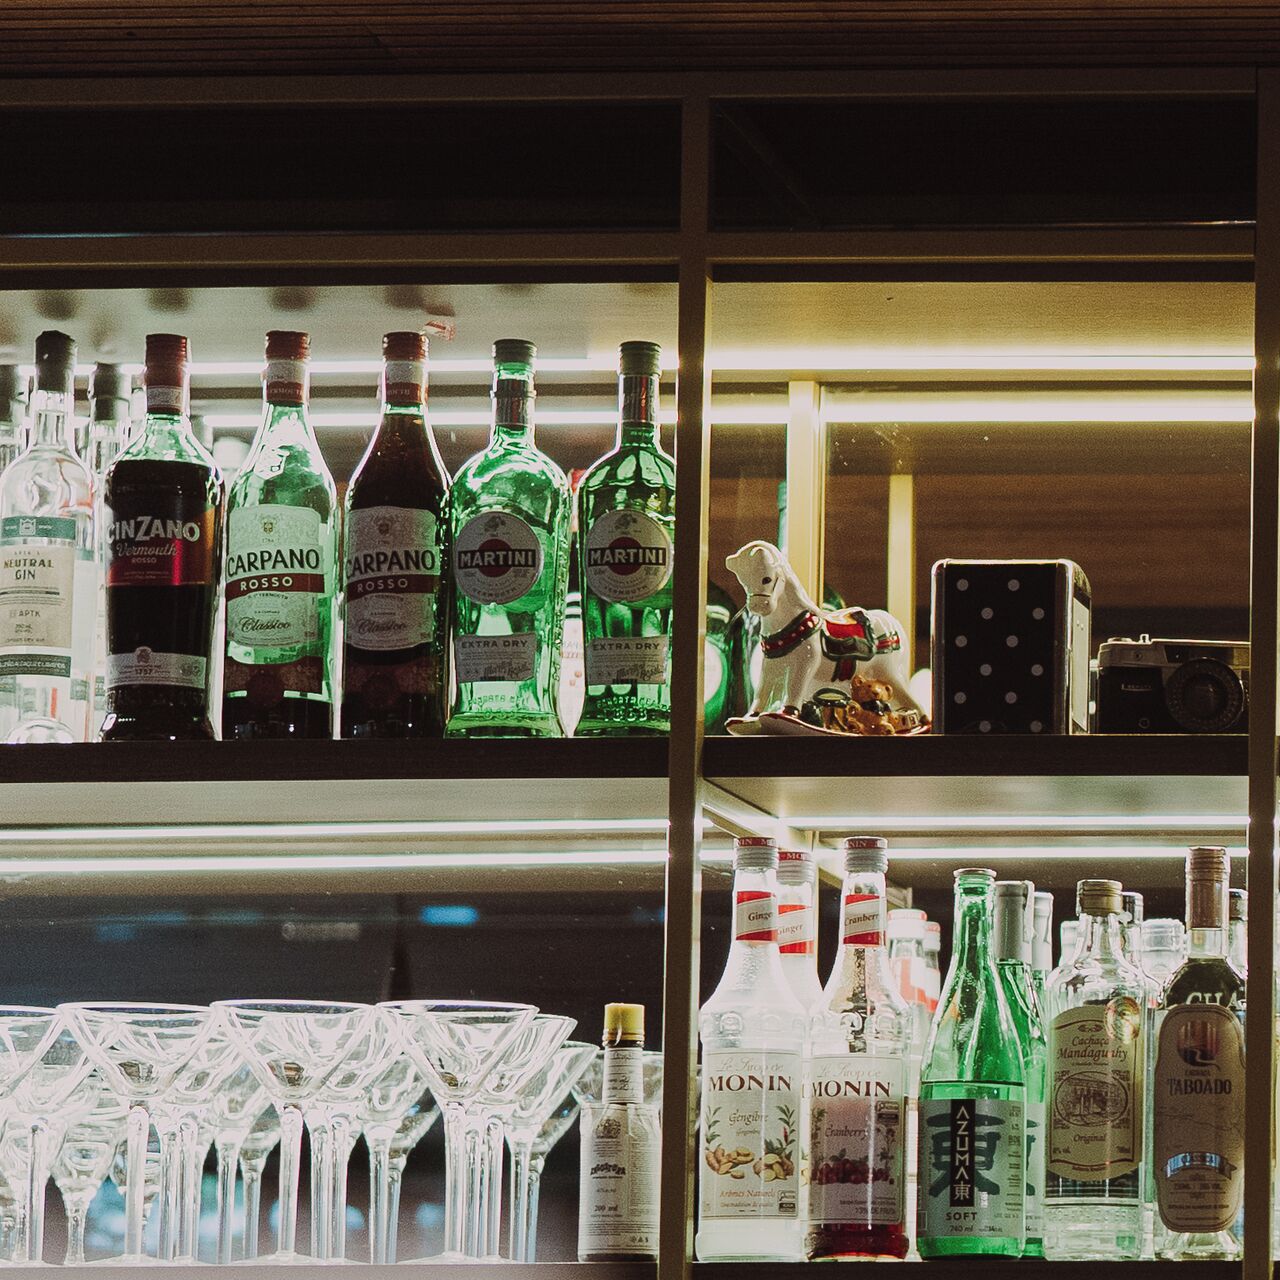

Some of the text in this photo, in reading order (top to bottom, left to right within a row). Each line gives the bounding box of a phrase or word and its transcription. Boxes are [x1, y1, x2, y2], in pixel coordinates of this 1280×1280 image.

[105, 515, 201, 544] CINZANO
[116, 542, 176, 557] Vermouth
[589, 548, 664, 565] MARTINI
[4, 558, 54, 569] NEUTRAL
[227, 548, 320, 577] CARPANO
[345, 549, 436, 579] CARPANO
[460, 551, 534, 567] MARTINI
[15, 569, 36, 580] GIN
[240, 576, 293, 592] ROSSO
[357, 578, 409, 593] ROSSO
[461, 639, 528, 649] EXTRA DRY
[593, 642, 660, 651] EXTRA DRY
[708, 1074, 791, 1092] MONIN
[811, 1079, 891, 1098] MONIN
[1168, 1078, 1232, 1096] TABOADO
[728, 1109, 769, 1126] Gengibre
[824, 1123, 868, 1141] Cranberry
[1073, 1134, 1106, 1145] Original
[953, 1180, 971, 1200] 東
[945, 1211, 977, 1221] SOFT
